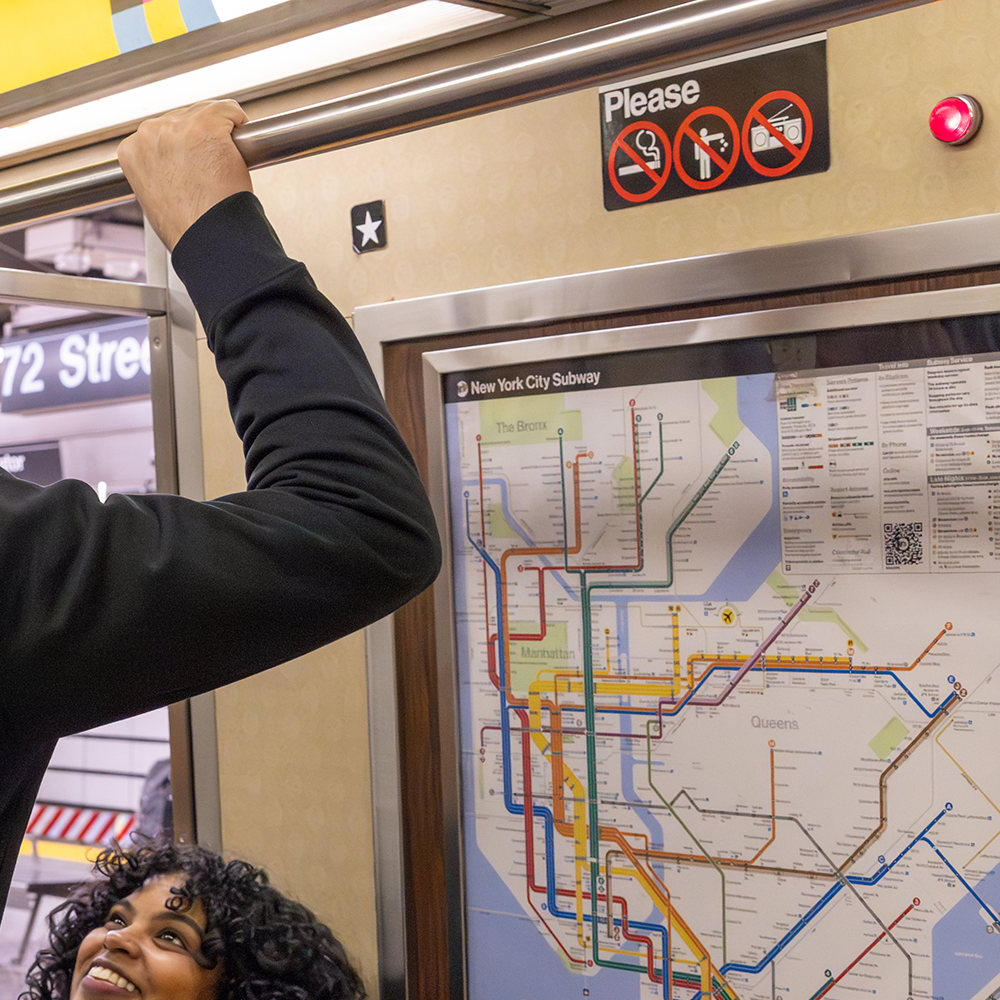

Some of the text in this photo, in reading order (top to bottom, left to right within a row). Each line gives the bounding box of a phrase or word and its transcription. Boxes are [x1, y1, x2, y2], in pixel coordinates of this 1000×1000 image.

[604, 79, 700, 123] Please
[1, 341, 45, 397] 72
[470, 371, 601, 395] New York City Subway
[496, 420, 548, 434] The Bronx
[521, 646, 576, 660] Manhattan
[751, 715, 800, 730] Queens
